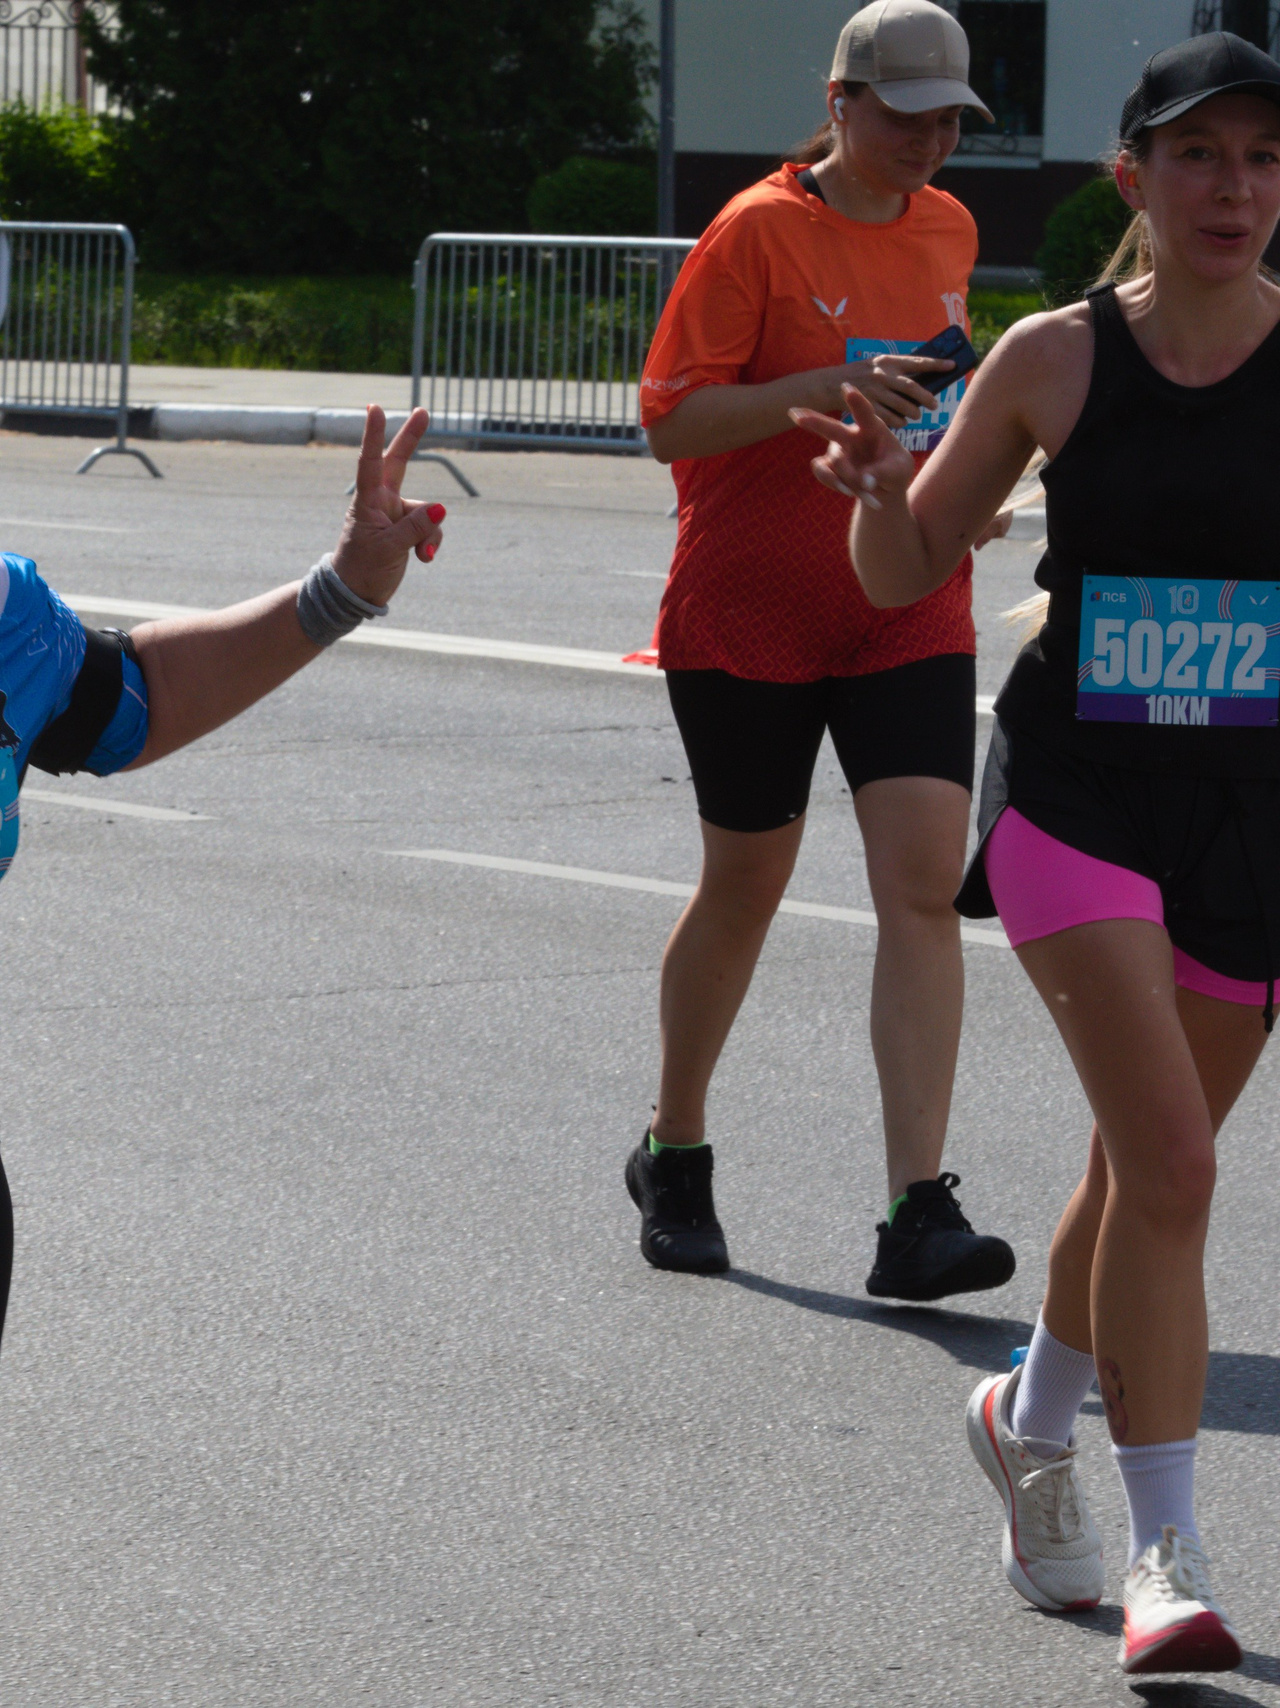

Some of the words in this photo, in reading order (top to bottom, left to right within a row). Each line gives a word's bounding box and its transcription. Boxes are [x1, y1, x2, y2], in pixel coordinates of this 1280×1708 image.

[1102, 592, 1127, 603] ПСБ
[1168, 585, 1200, 614] 10
[1092, 618, 1267, 690] 50272
[1146, 694, 1210, 726] 10KM
